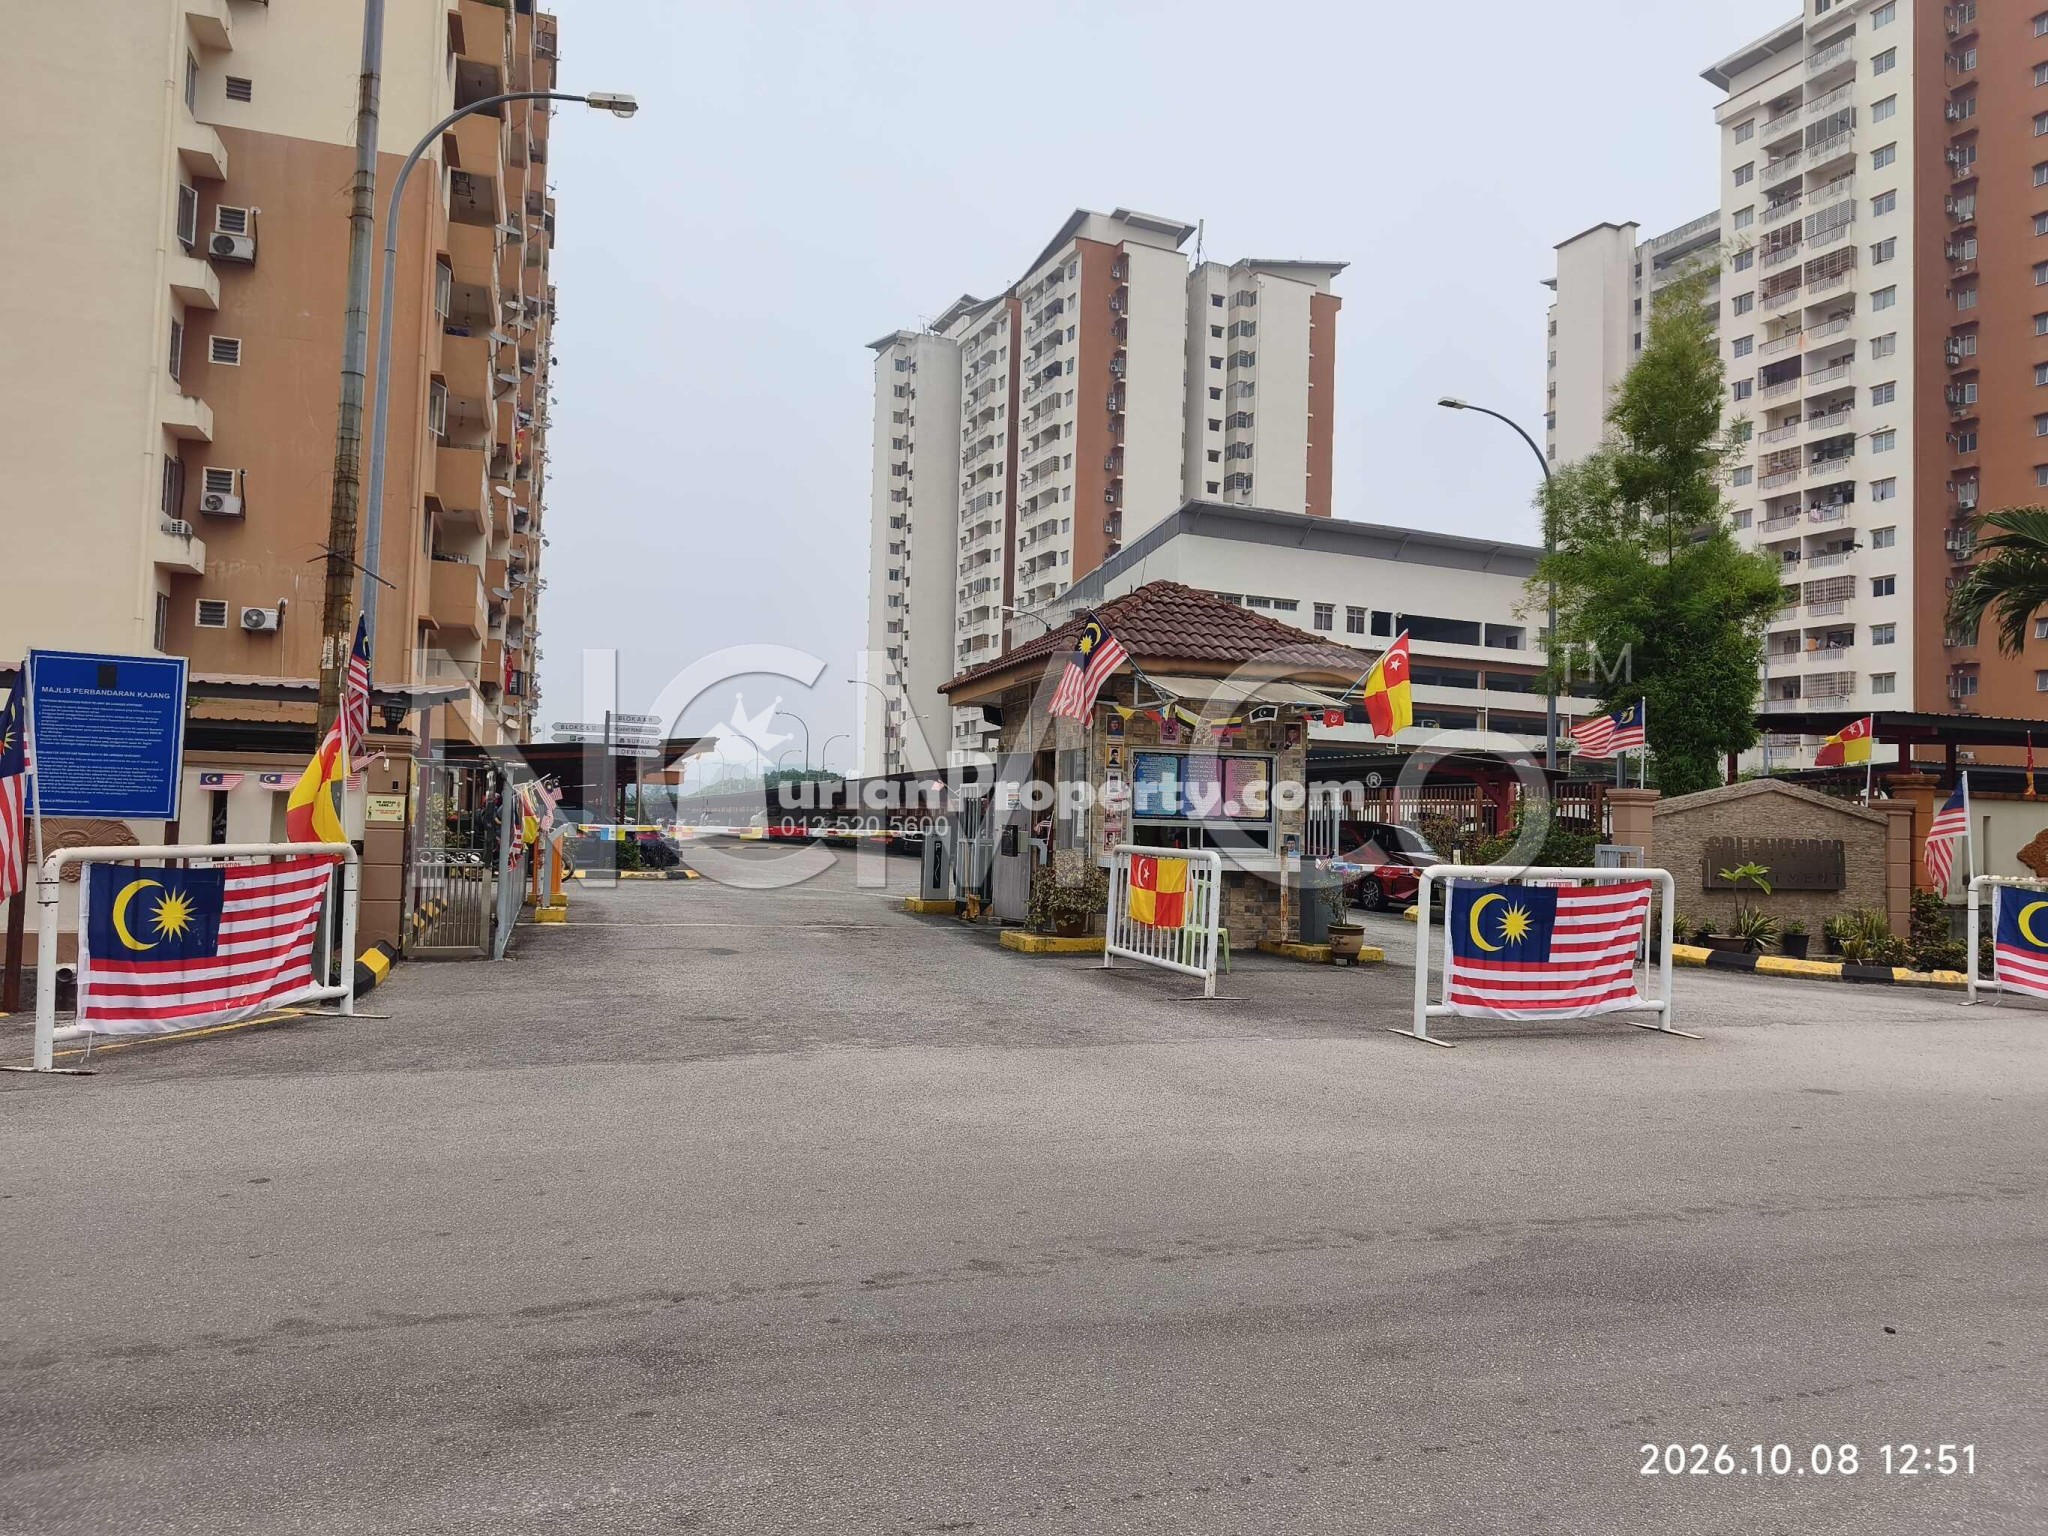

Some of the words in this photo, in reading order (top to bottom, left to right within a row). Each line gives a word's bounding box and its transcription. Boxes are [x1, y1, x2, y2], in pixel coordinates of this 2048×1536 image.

[41, 686, 72, 695] MAJLIS
[73, 688, 136, 698] PERBANDARAN
[137, 692, 171, 700] KAJANG
